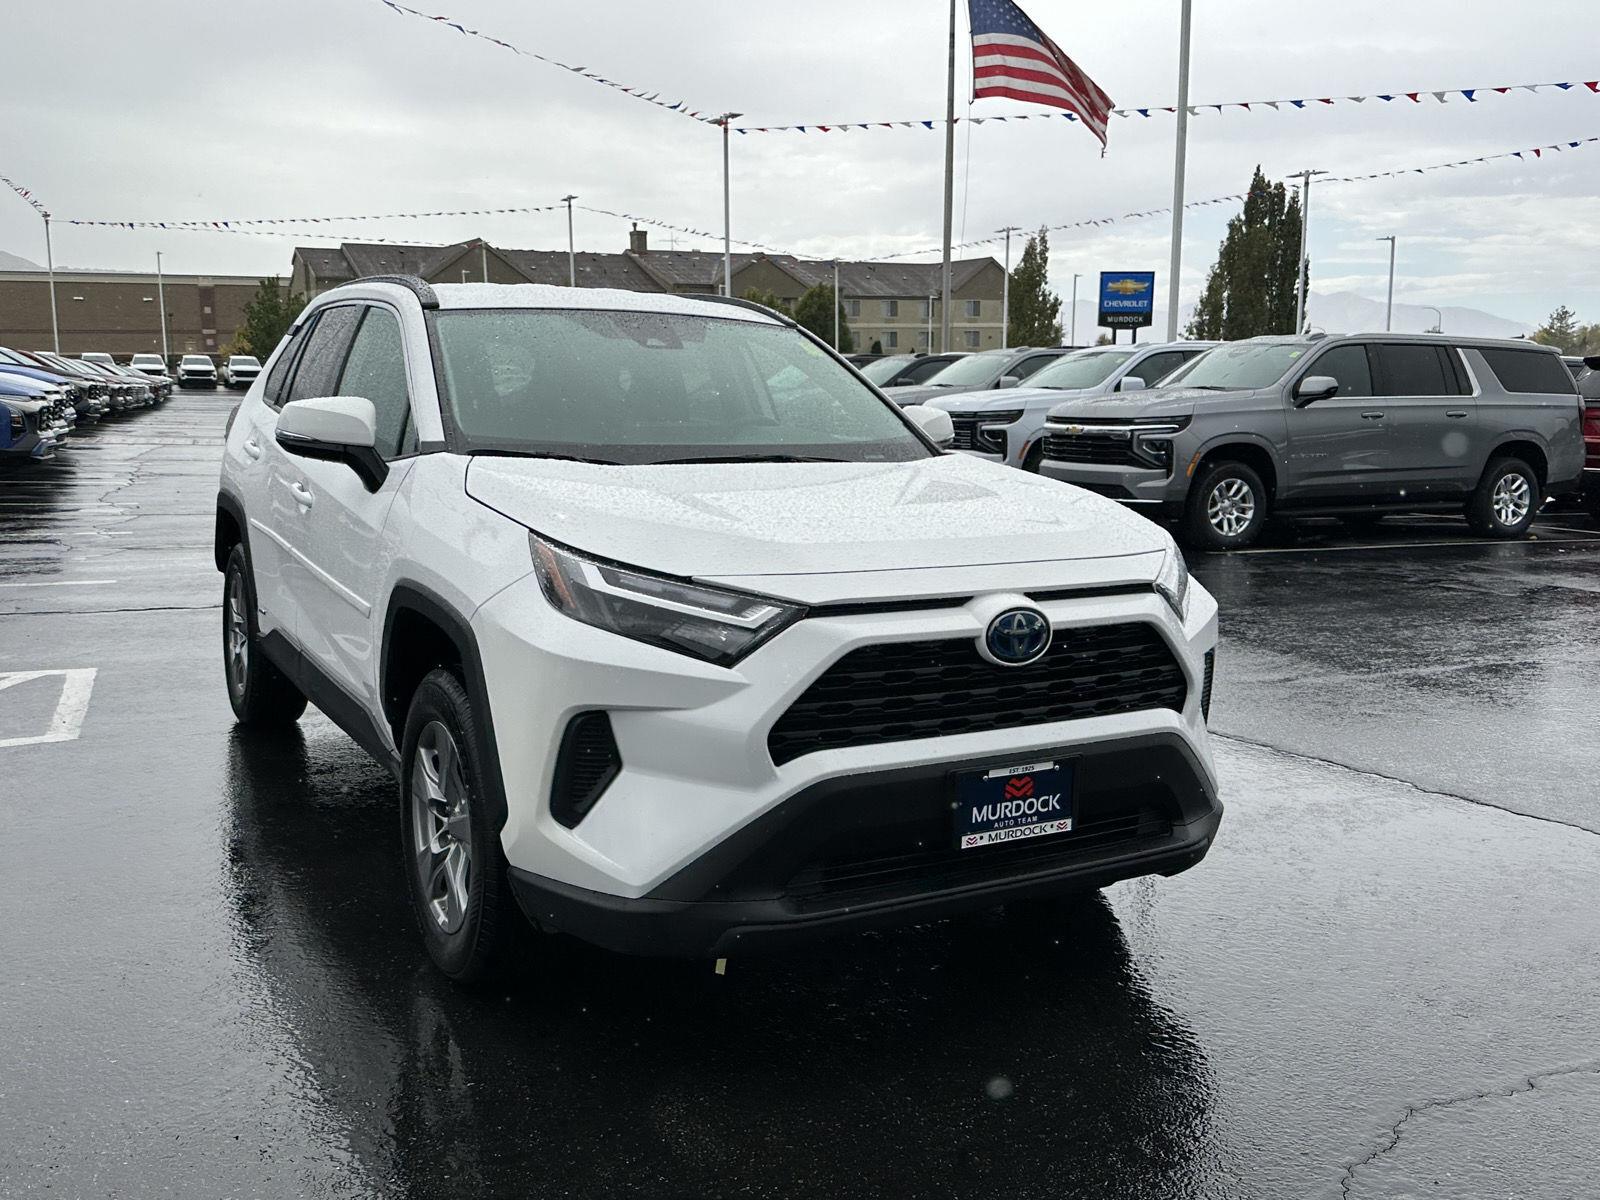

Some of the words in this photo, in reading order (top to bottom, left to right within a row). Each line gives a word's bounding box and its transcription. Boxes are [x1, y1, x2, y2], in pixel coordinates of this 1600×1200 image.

[972, 793, 1061, 823] MURDOCK
[993, 819, 1015, 829] AUTO
[1018, 815, 1038, 825] TEAM
[988, 824, 1048, 843] MURDOCK
